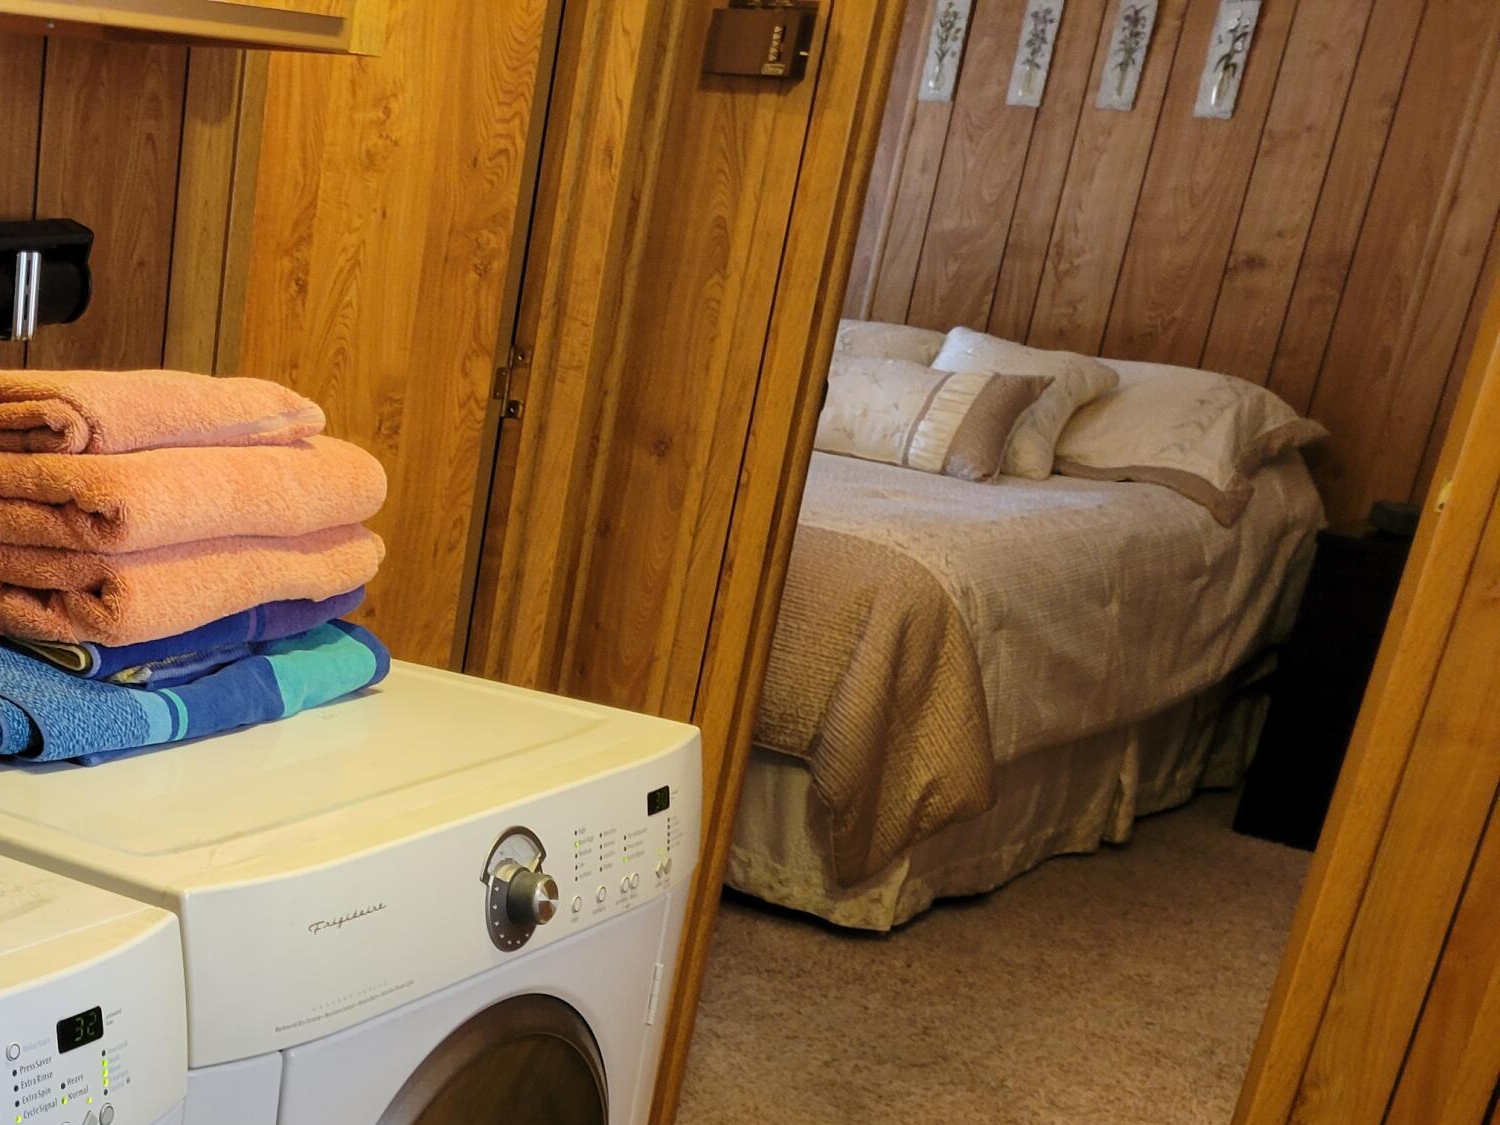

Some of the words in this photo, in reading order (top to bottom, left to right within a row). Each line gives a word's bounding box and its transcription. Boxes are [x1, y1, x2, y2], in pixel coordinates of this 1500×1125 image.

[308, 902, 387, 935] Frigidaire
[75, 1012, 98, 1042] 32
[19, 1063, 36, 1074] Press
[35, 1056, 52, 1068] Saver
[20, 1077, 37, 1089] Extra
[37, 1072, 53, 1083] Rinse
[66, 1074, 84, 1086] Heavy
[22, 1093, 38, 1105] Extra
[37, 1087, 51, 1099] Spin
[67, 1084, 89, 1101] Normal
[23, 1107, 40, 1120] Cycle
[39, 1097, 58, 1113] Signal
